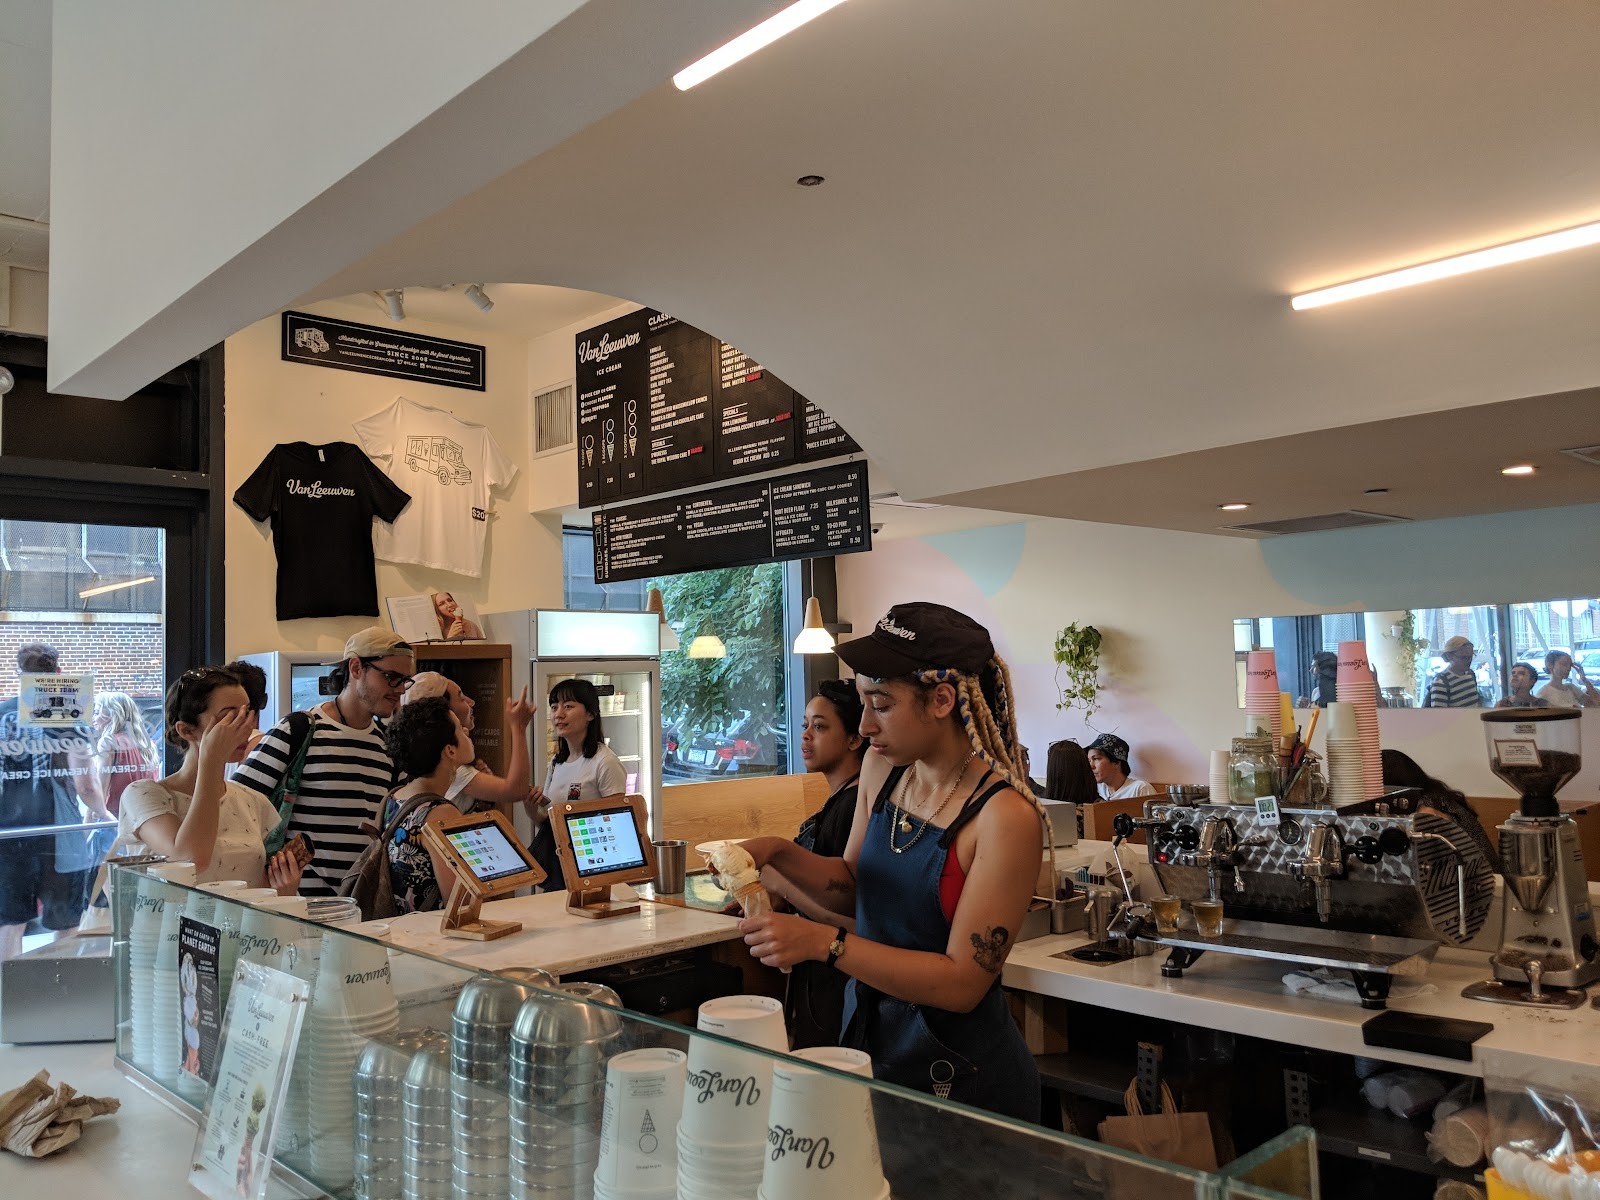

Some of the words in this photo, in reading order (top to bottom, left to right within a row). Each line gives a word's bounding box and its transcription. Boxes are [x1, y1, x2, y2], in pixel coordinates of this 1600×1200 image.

[648, 313, 672, 326] CLASS
[386, 350, 409, 360] SINCE
[596, 368, 604, 376] ICE
[605, 363, 622, 374] CREAM
[472, 508, 486, 520] $20
[184, 927, 194, 935] WHAT
[199, 933, 210, 941] EARTH
[182, 934, 198, 948] PLANET
[198, 941, 216, 955] EARTH?
[242, 1028, 268, 1049] CASH-FREE
